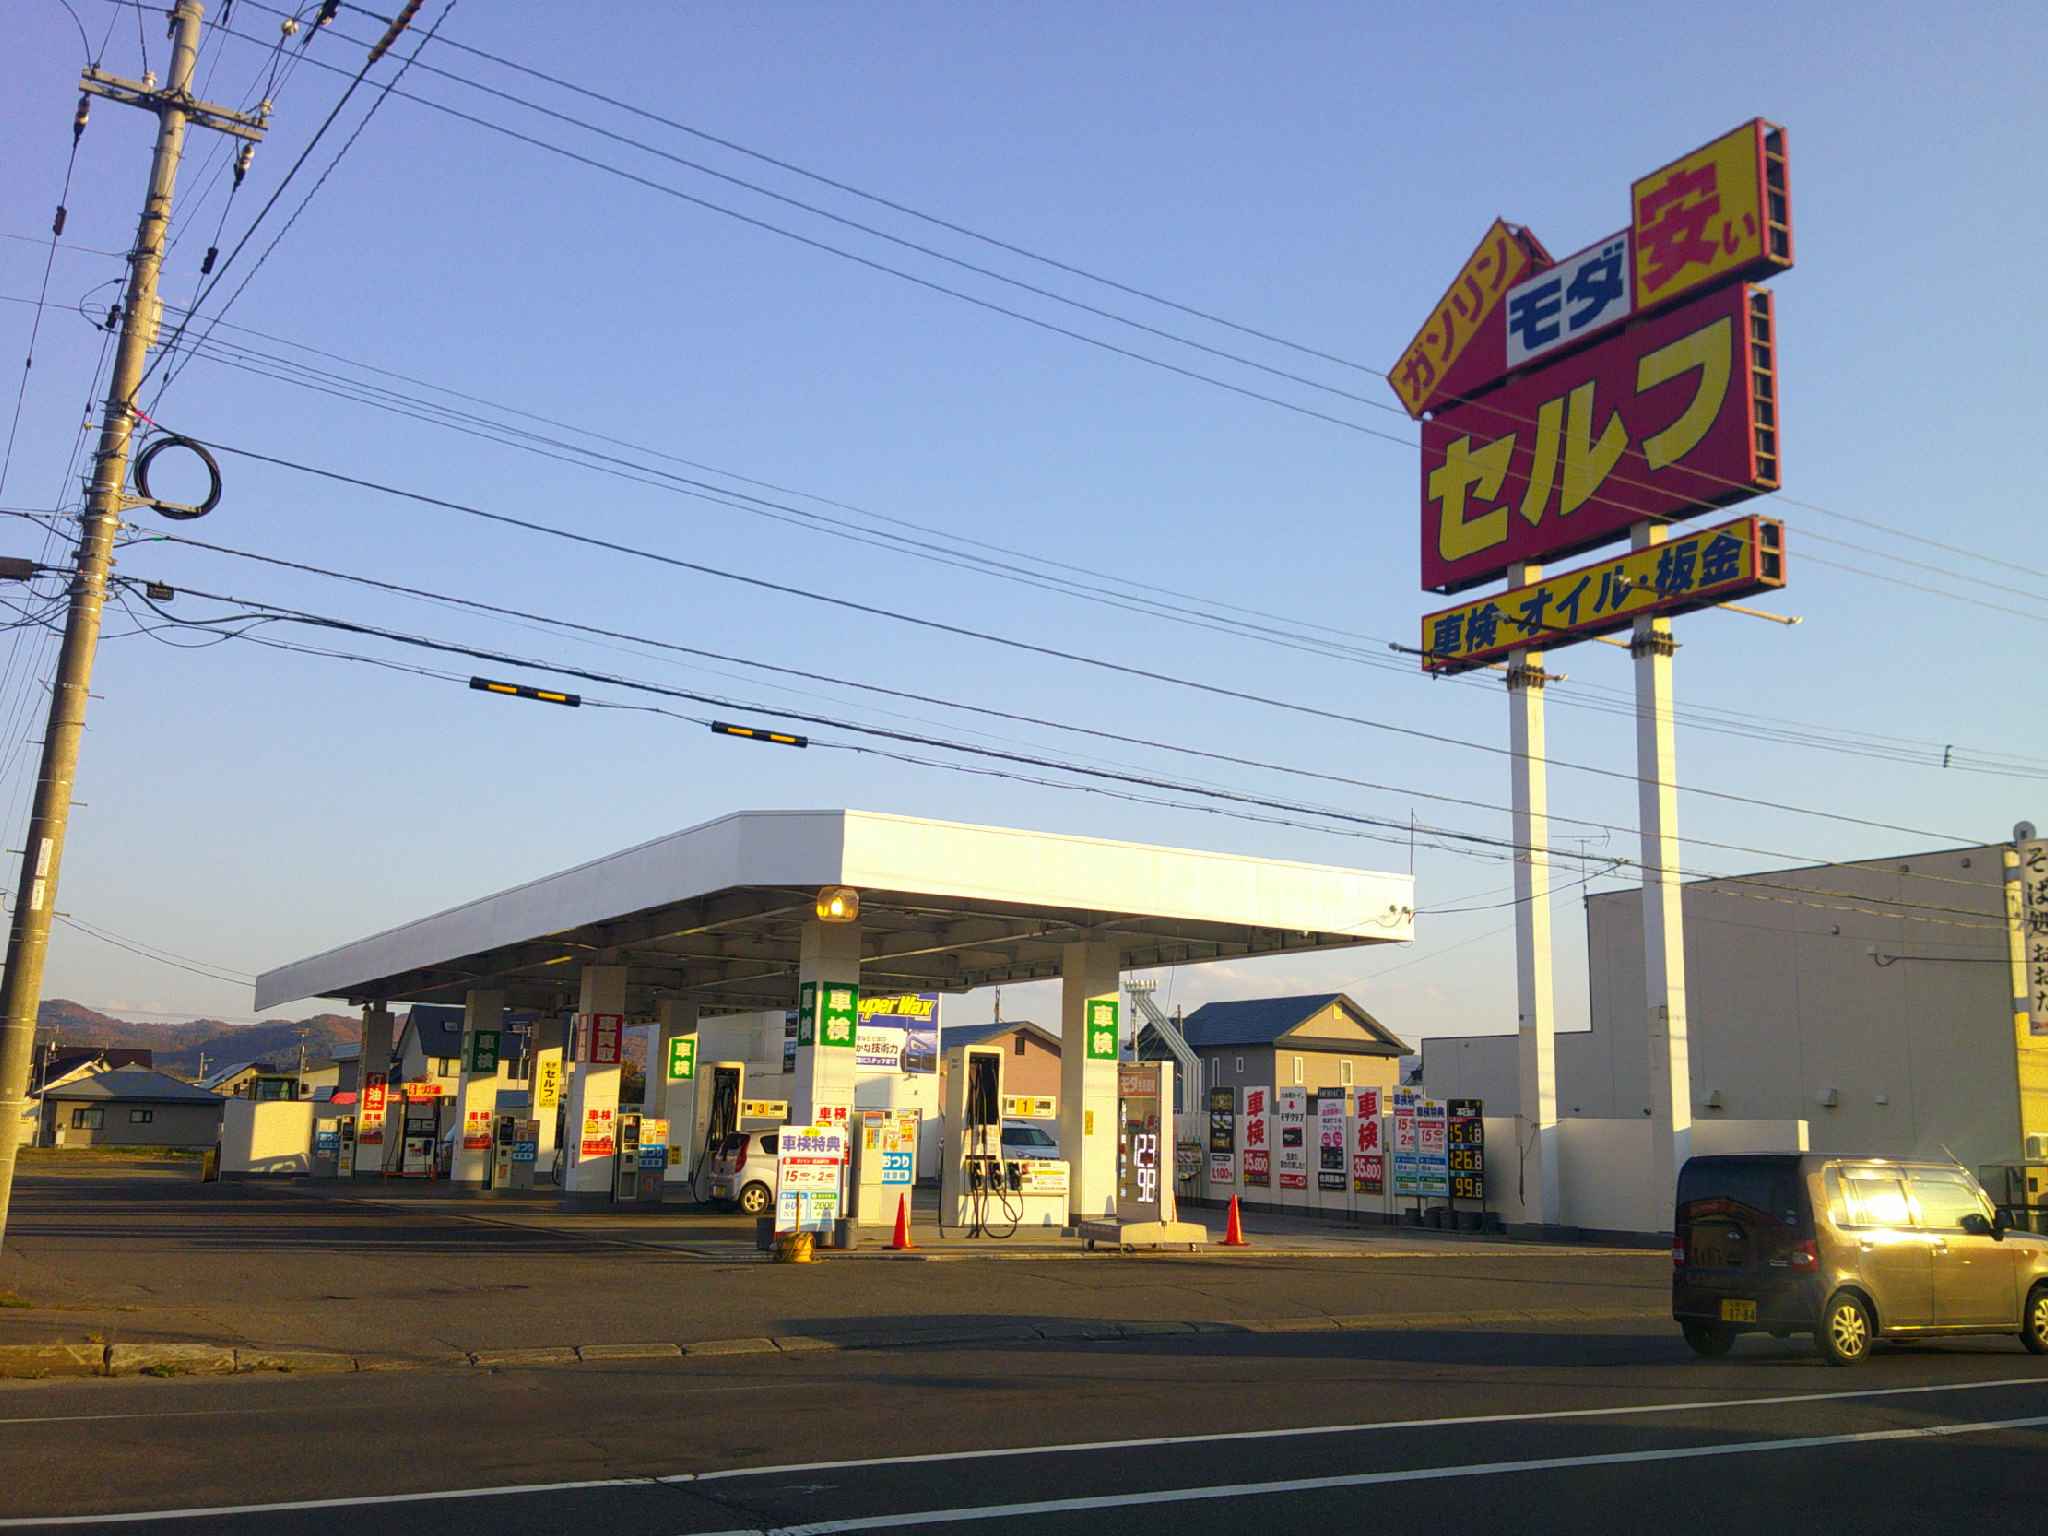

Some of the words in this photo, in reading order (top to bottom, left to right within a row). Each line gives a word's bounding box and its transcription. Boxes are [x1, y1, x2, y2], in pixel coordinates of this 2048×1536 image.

[1637, 163, 1755, 294] 安い
[1509, 240, 1625, 352] モダ
[1402, 236, 1508, 401] ガソリン
[1428, 314, 1734, 563] セルフ
[1433, 530, 1745, 654] 車検オイル・板金
[827, 990, 852, 1040] 車検
[858, 997, 899, 1020] uper
[898, 994, 933, 1016] Wax
[1093, 1005, 1114, 1054] 車検
[674, 1041, 692, 1076] 車検
[544, 1070, 556, 1098] セルフ
[758, 1103, 765, 1114] 3
[819, 1107, 847, 1121] 車検
[1022, 1101, 1028, 1113] 1
[1247, 1090, 1265, 1146] 車検
[1357, 1091, 1378, 1152] 車検
[782, 1135, 840, 1152] 車検特典
[785, 1170, 799, 1182] 15
[817, 1172, 825, 1181] 2
